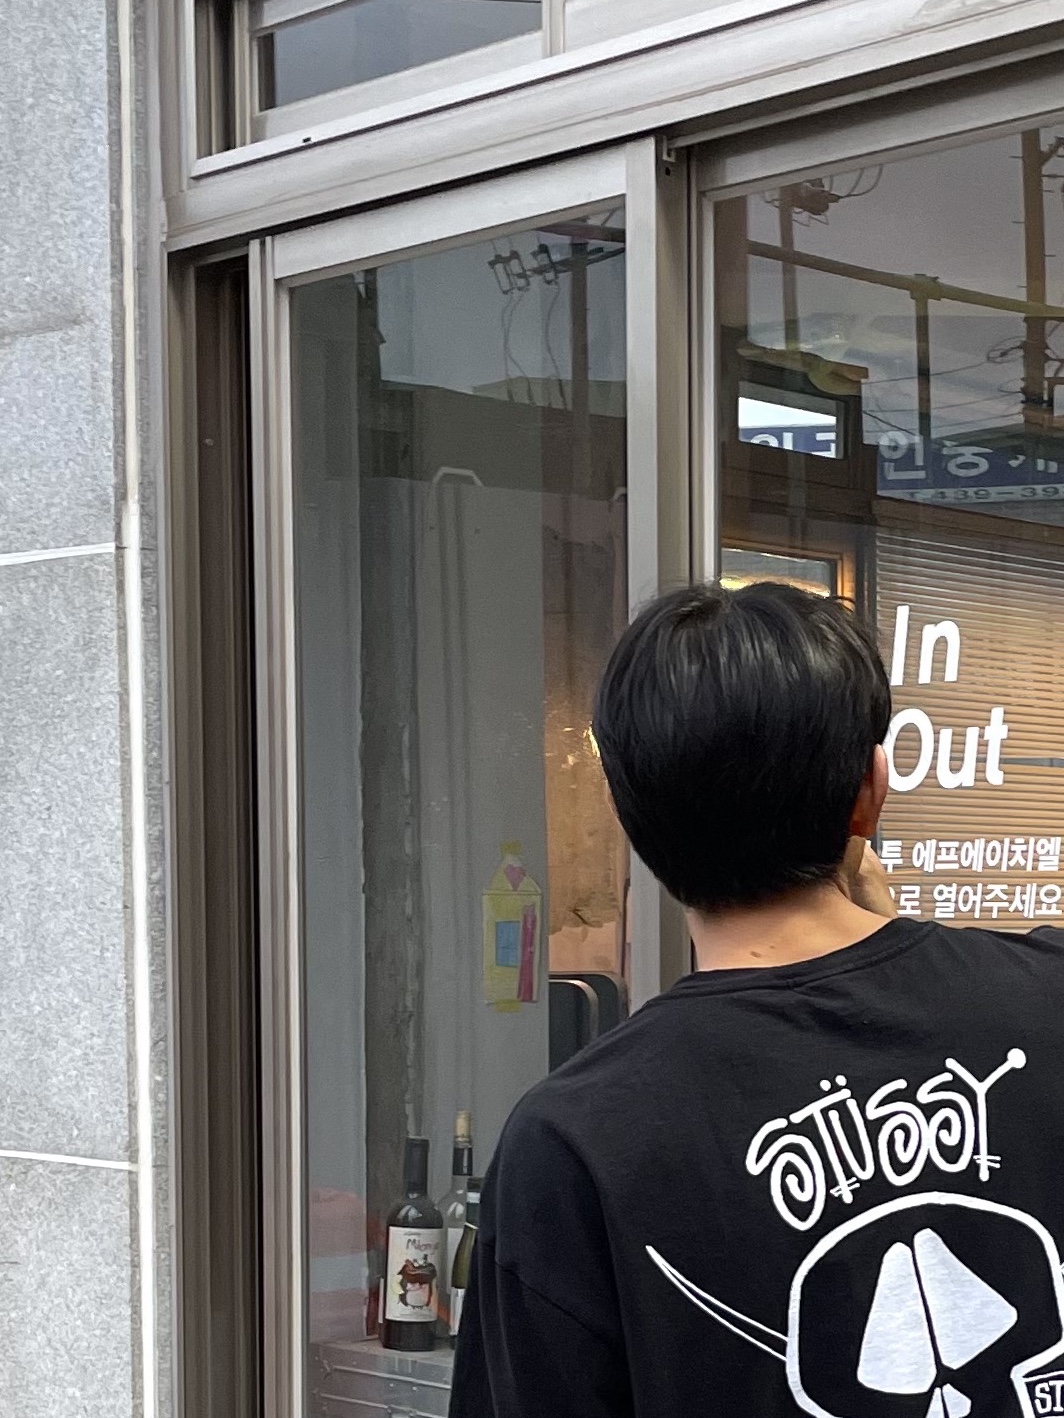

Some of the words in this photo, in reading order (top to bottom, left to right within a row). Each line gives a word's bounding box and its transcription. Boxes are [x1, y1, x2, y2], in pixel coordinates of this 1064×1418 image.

[891, 605, 961, 686] In
[884, 707, 1008, 792] Out
[912, 837, 1061, 873] 에프에이치엘
[889, 884, 921, 915] 로
[933, 883, 1063, 919] 열어주세요
